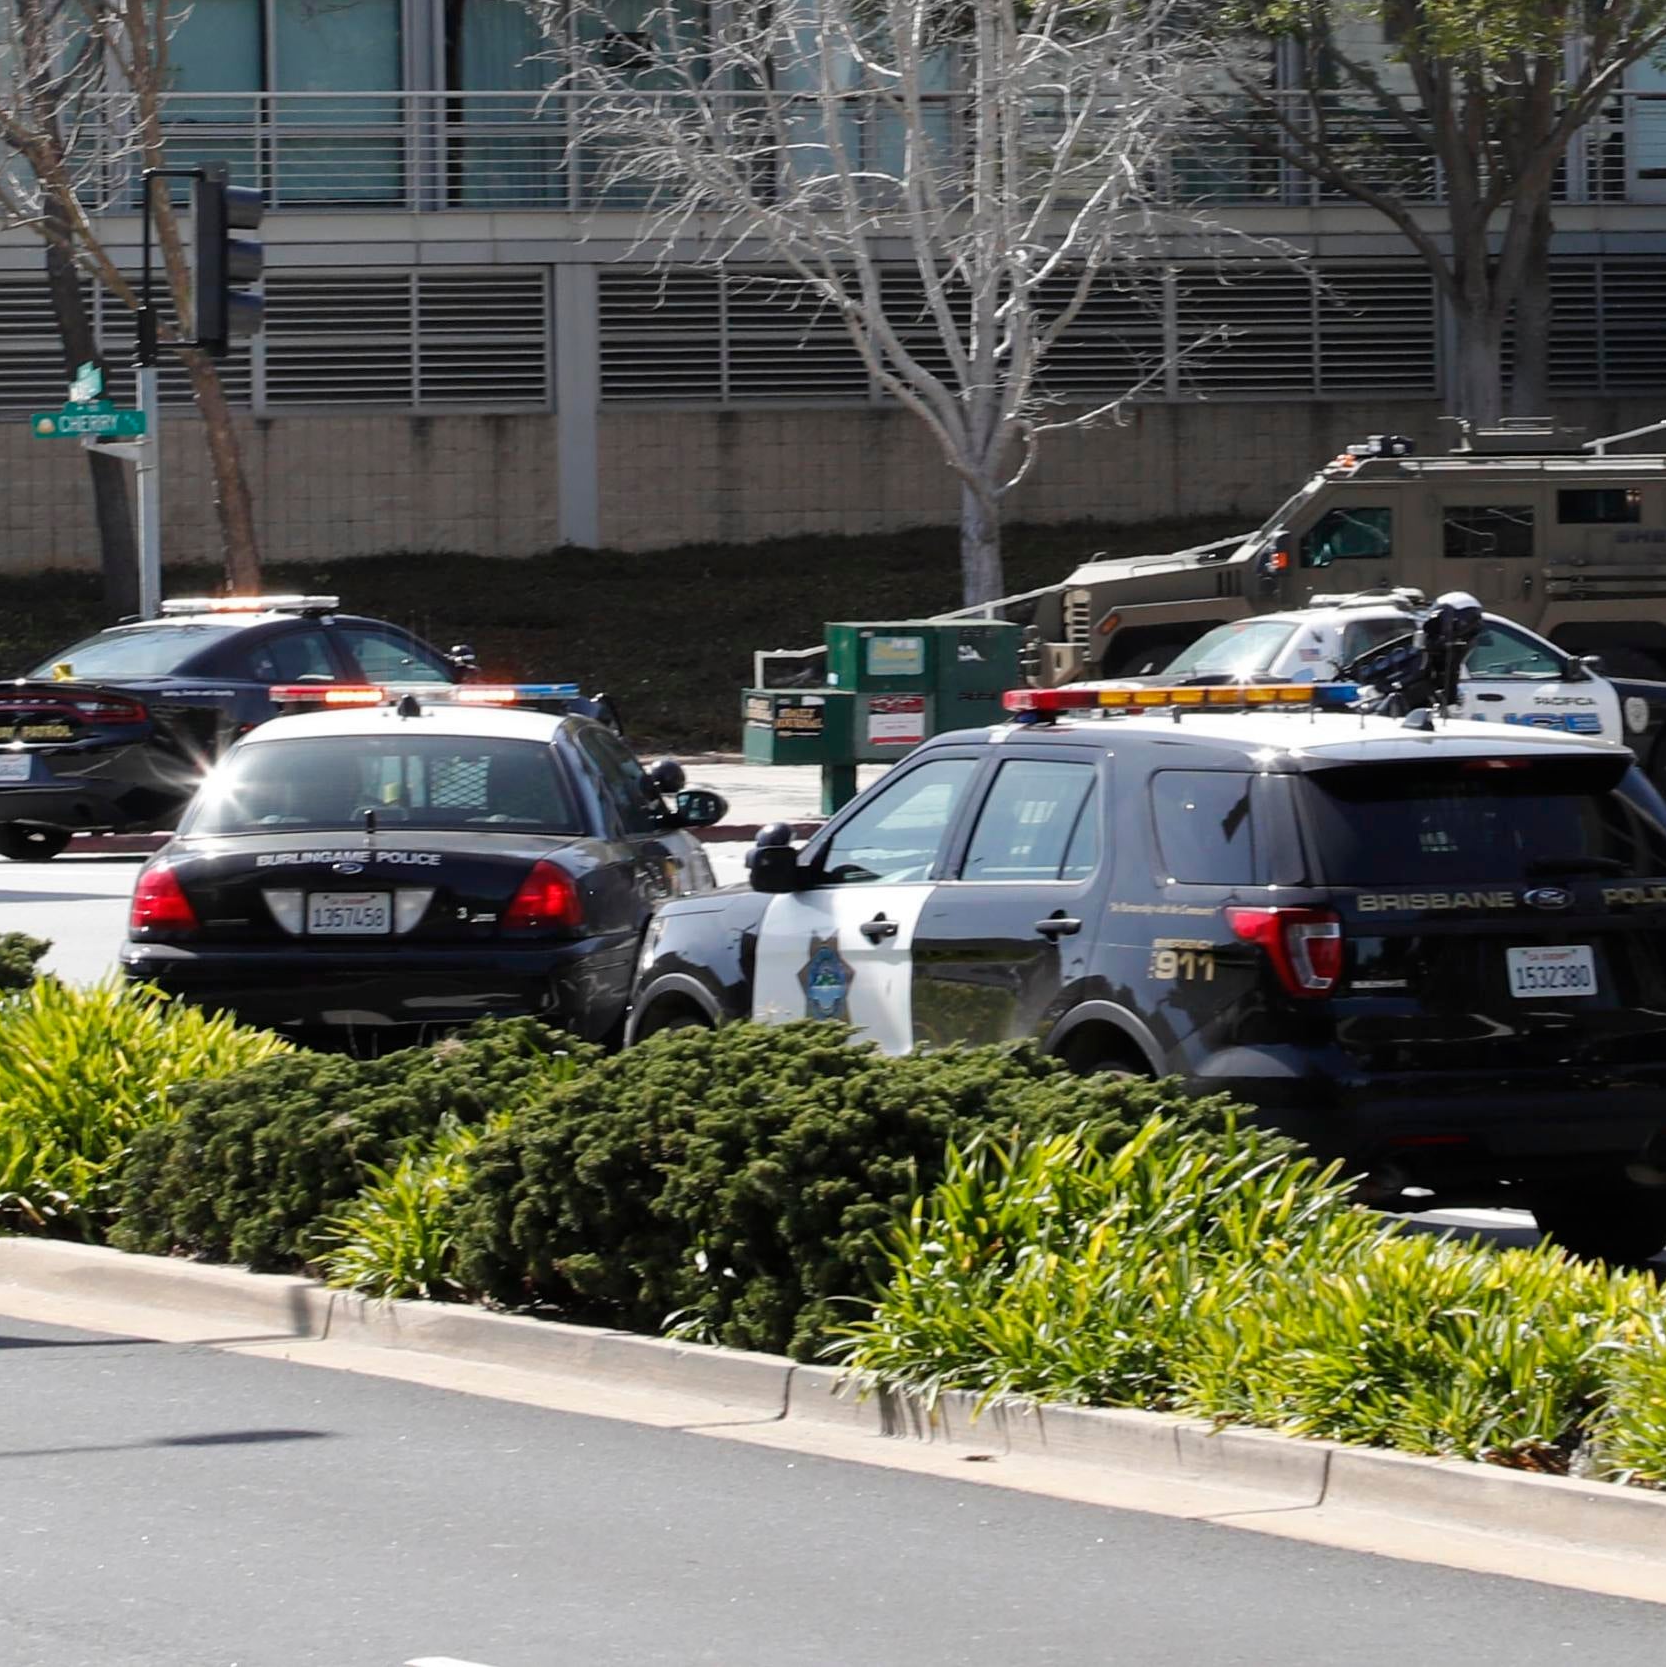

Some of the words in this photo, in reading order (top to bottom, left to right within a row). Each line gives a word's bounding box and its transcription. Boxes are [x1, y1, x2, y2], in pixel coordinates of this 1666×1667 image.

[58, 415, 119, 432] CHERRY
[256, 851, 371, 867] BURLINGAME
[376, 852, 441, 866] POLICE
[1357, 891, 1515, 912] BRISBANE
[313, 907, 384, 928] 1357458
[1155, 950, 1214, 981] 911
[1516, 966, 1590, 990] 1532380
